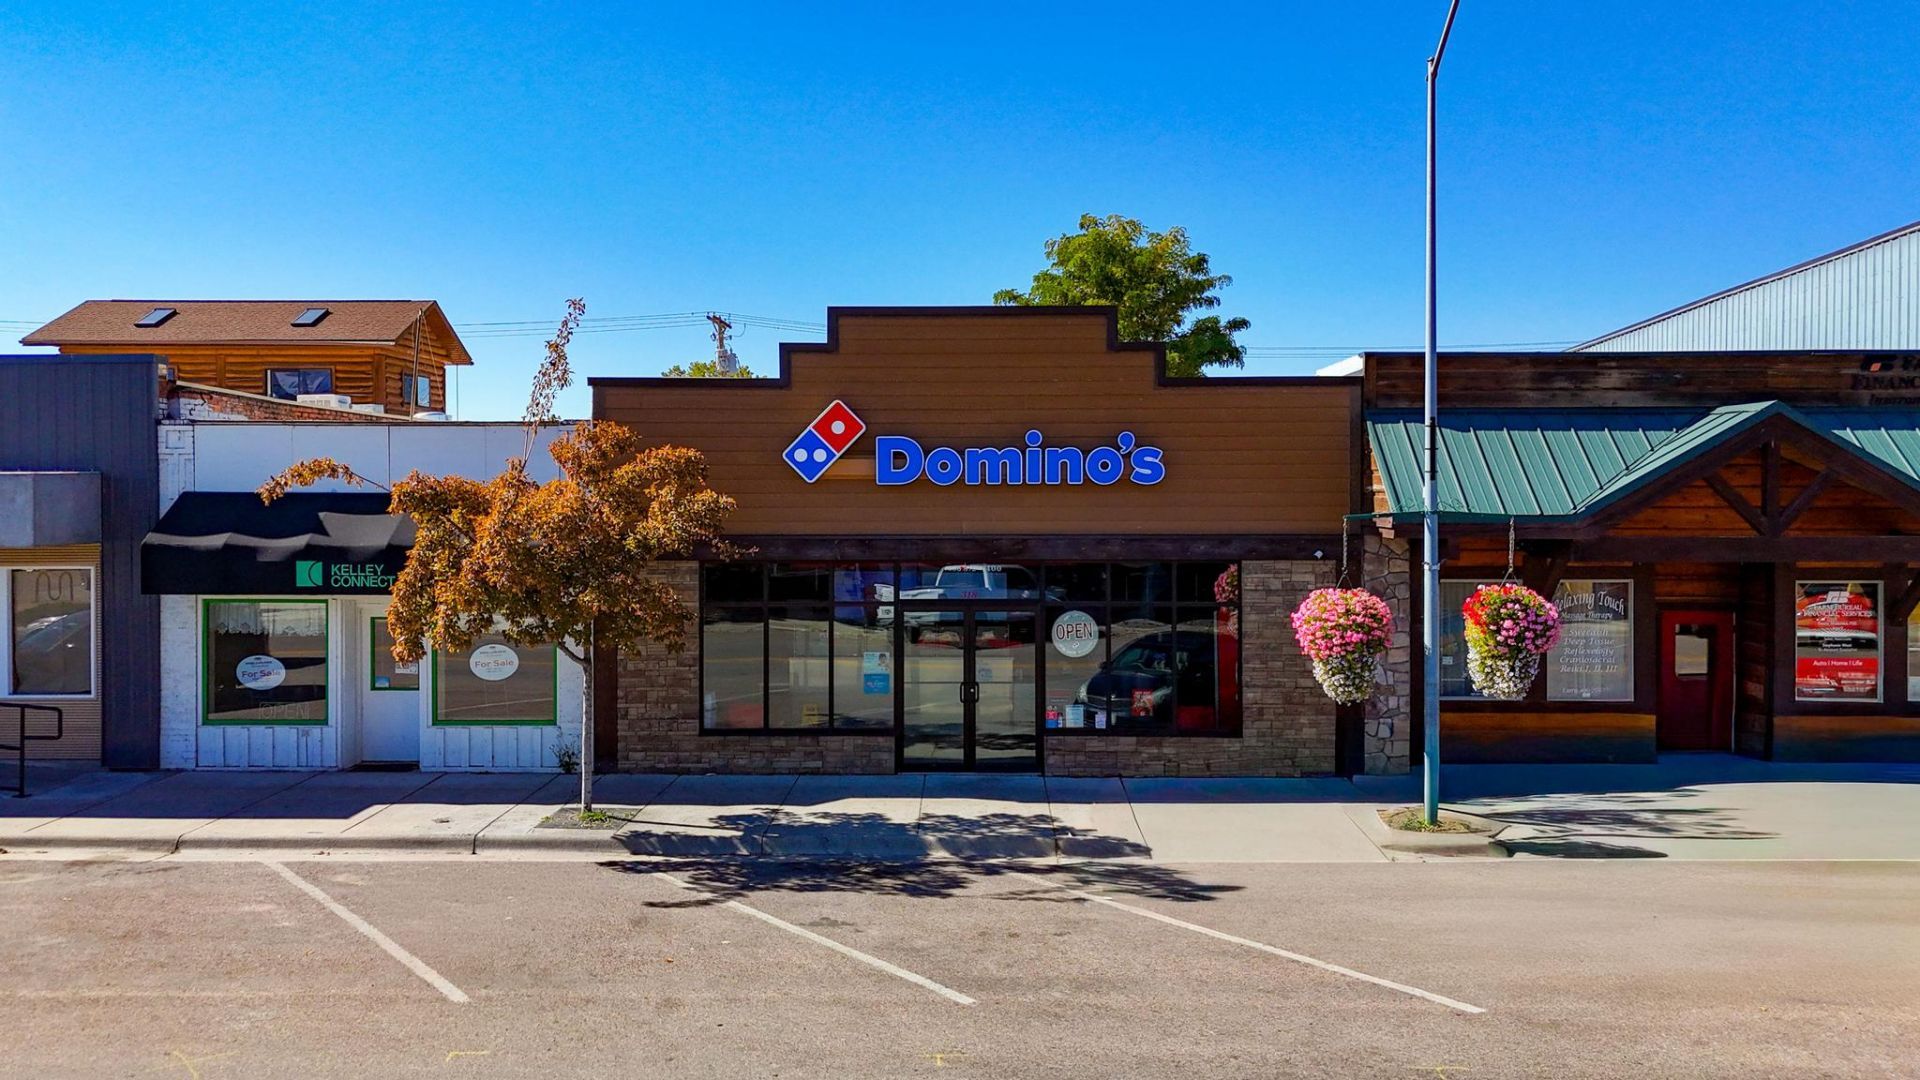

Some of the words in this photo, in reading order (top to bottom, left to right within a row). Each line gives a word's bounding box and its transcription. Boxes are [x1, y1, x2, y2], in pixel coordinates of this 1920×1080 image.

[875, 429, 1166, 486] Domino's
[331, 564, 384, 576] KELLEY
[331, 576, 396, 587] CONNECT
[1598, 591, 1624, 615] Touch
[1056, 622, 1093, 640] OPEN
[1564, 638, 1585, 647] Deep
[1589, 637, 1615, 645] Tissue
[493, 659, 514, 667] Sale
[241, 670, 258, 678] For
